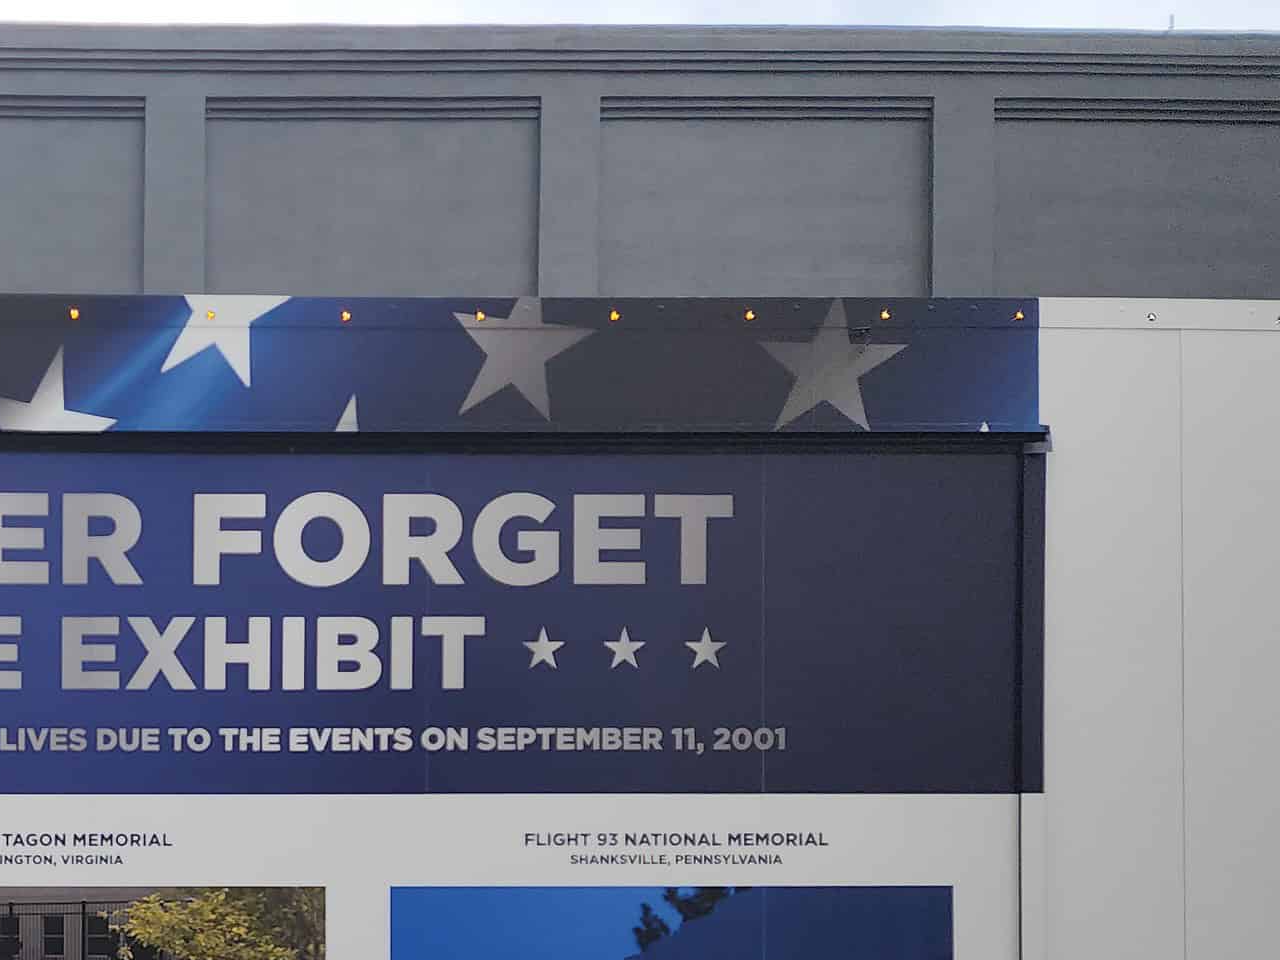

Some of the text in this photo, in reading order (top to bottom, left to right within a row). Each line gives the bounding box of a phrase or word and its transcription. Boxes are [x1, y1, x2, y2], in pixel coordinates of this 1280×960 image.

[192, 491, 734, 588] FORGET
[60, 615, 486, 692] EXHIBIT
[0, 727, 88, 752] LIVES
[96, 727, 161, 752] DUE
[167, 727, 212, 752] TO
[218, 727, 281, 753] THE
[288, 727, 414, 753] EVENTS
[420, 727, 469, 752] ON
[475, 727, 665, 752] SEPTEMBER
[671, 727, 706, 755] 11,
[712, 727, 787, 752] 2001
[72, 832, 174, 848] MEMORIAL
[524, 832, 830, 847] FLIGHT 93 NATIONAL MEMORIAL
[60, 854, 124, 865] VIRGINIA
[569, 853, 784, 867] SHANKSVILLE, PENNSYLVANIA
